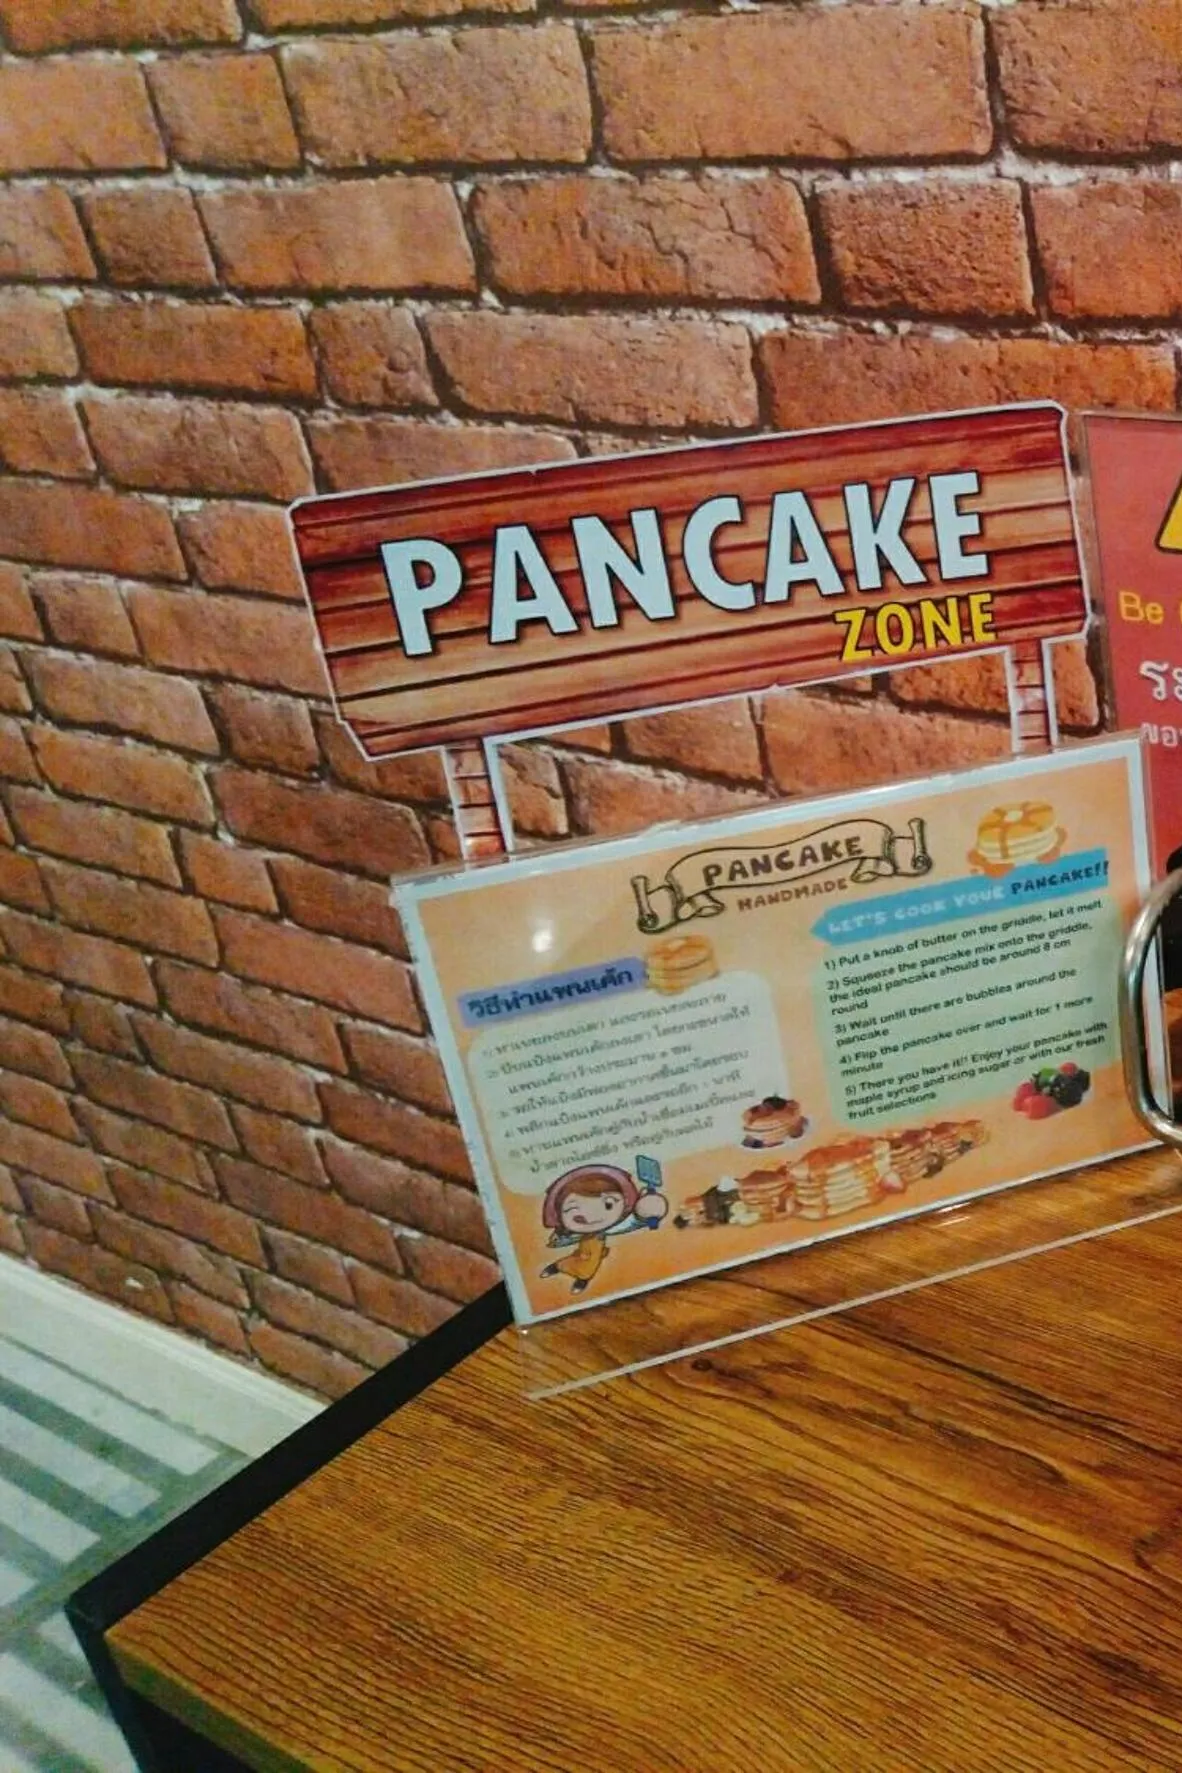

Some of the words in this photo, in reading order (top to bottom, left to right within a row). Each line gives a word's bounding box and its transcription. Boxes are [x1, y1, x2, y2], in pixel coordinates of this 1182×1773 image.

[380, 471, 989, 656] PANCAKE
[835, 594, 998, 662] ZONE
[1119, 591, 1164, 624] Be
[703, 837, 863, 886] PANCAKE
[737, 879, 848, 911] HANDMADE
[828, 910, 886, 933] LET'S
[893, 899, 946, 920] COOK
[1010, 860, 1108, 894] PANCAKE!!
[838, 953, 860, 967] Put
[861, 952, 871, 961] a
[872, 944, 904, 958] knob
[906, 938, 919, 951] of
[920, 932, 957, 947] butter
[960, 928, 977, 939] on
[978, 923, 998, 934] the
[1048, 907, 1064, 919] let
[1065, 905, 1074, 915] it
[841, 966, 895, 986] Squeeze
[897, 961, 917, 973] the
[919, 948, 972, 968] pancake
[973, 943, 995, 954] mix
[996, 936, 1024, 949] onto
[1025, 931, 1045, 942] the
[828, 992, 849, 1003] the
[851, 982, 882, 997] ideal
[884, 970, 936, 992] pancake
[939, 958, 979, 976] should
[980, 955, 997, 966] be
[999, 944, 1041, 962] around
[1052, 938, 1071, 949] cm
[848, 1016, 877, 1030] Wait
[879, 1008, 907, 1024] until
[908, 1002, 941, 1016] there
[942, 996, 963, 1008] are
[965, 984, 1012, 1001] bubbles
[1015, 971, 1056, 990] around
[1057, 968, 1076, 979] the
[830, 998, 868, 1015] round
[835, 1028, 889, 1047] pancake
[853, 1049, 877, 1061] Flip
[879, 1044, 899, 1055] the
[901, 1030, 953, 1051] pancake
[954, 1023, 981, 1036] over
[983, 1015, 1006, 1029] and
[1008, 1009, 1033, 1022] wait
[1034, 1005, 1050, 1016] for
[1063, 995, 1093, 1008] more
[840, 1061, 883, 1076] minute
[846, 1092, 883, 1107] maple
[886, 1083, 920, 1099] syrup
[922, 1074, 945, 1088] and
[946, 1068, 976, 1081] icing
[977, 1059, 1010, 1074] sugar
[1028, 1048, 1052, 1060] with
[1053, 1042, 1073, 1054] our
[1075, 1034, 1105, 1048] fresh
[858, 1077, 894, 1091] There
[896, 1070, 920, 1085] you
[920, 1062, 949, 1075] have
[970, 1048, 1003, 1063] Enjoy
[1004, 1041, 1030, 1056] your
[1032, 1029, 1082, 1048] pancake
[1084, 1021, 1108, 1033] with
[847, 1106, 875, 1119] fruit
[875, 1091, 936, 1113] selections
